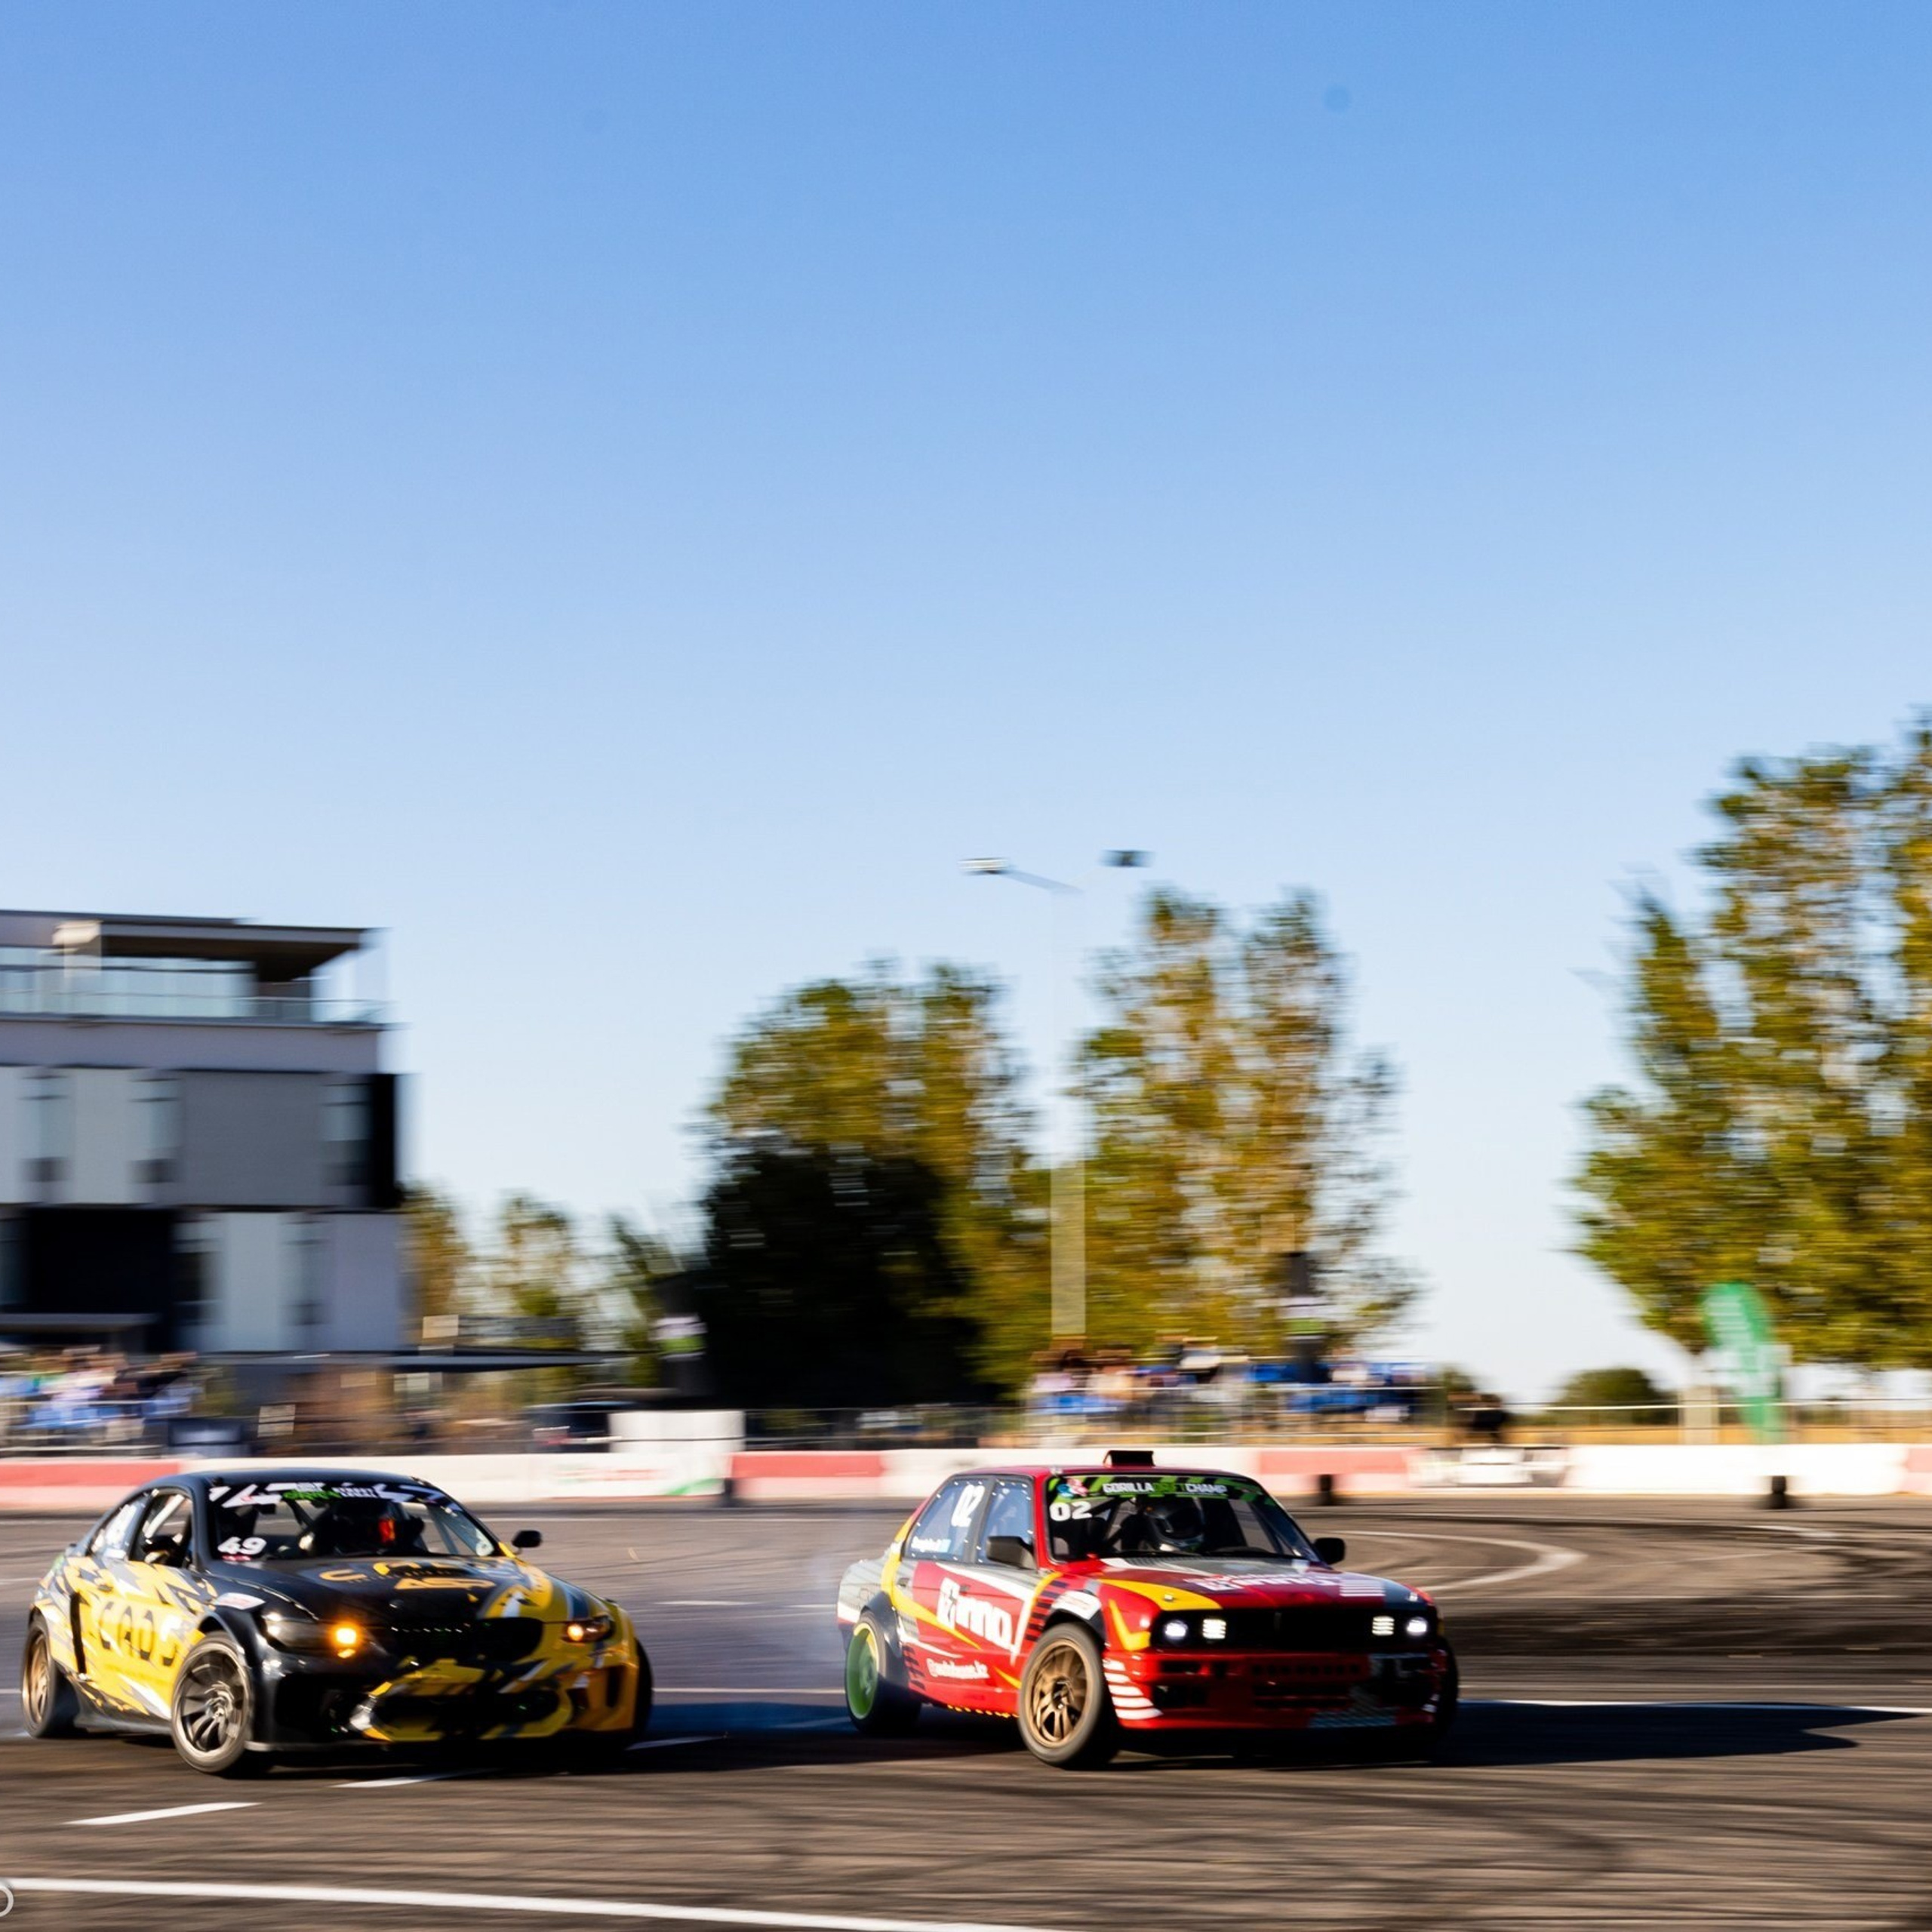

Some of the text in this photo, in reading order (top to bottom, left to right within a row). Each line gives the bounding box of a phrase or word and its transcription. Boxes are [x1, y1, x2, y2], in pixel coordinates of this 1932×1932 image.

[1103, 1483, 1154, 1494] GORILLA
[1186, 1483, 1227, 1494] CHAMP
[1050, 1501, 1092, 1522] 02
[217, 1537, 266, 1555] 49
